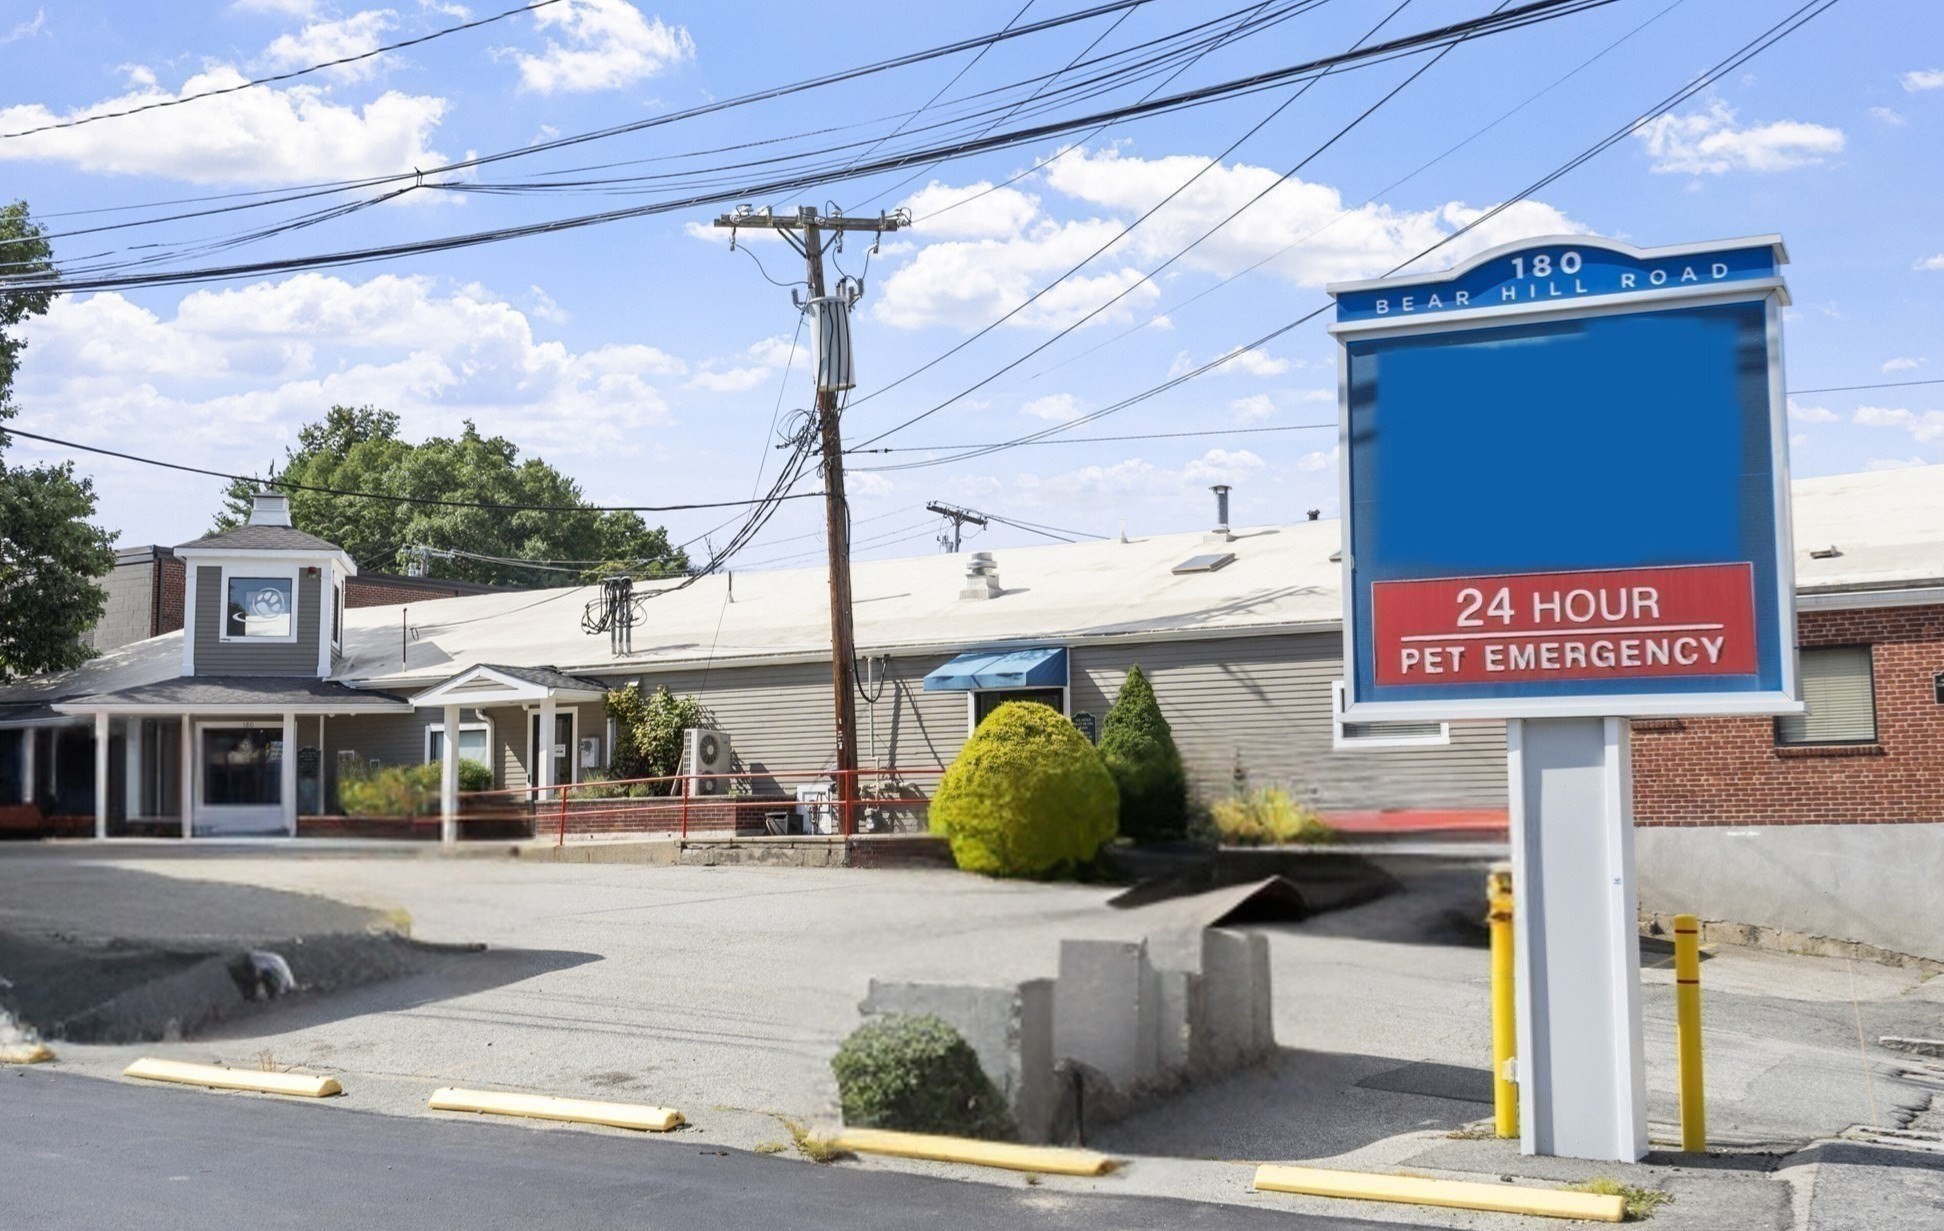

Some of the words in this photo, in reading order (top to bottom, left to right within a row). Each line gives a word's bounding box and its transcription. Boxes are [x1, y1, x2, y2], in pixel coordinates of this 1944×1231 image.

[1511, 251, 1582, 280] 180
[1376, 291, 1470, 315] BEAR
[1501, 278, 1588, 301] HILL
[1620, 262, 1728, 289] ROAD
[1456, 586, 1515, 627] 24
[1533, 586, 1660, 624] HOUR
[1401, 645, 1466, 674] PET
[1484, 636, 1724, 673] EMERGENCY
